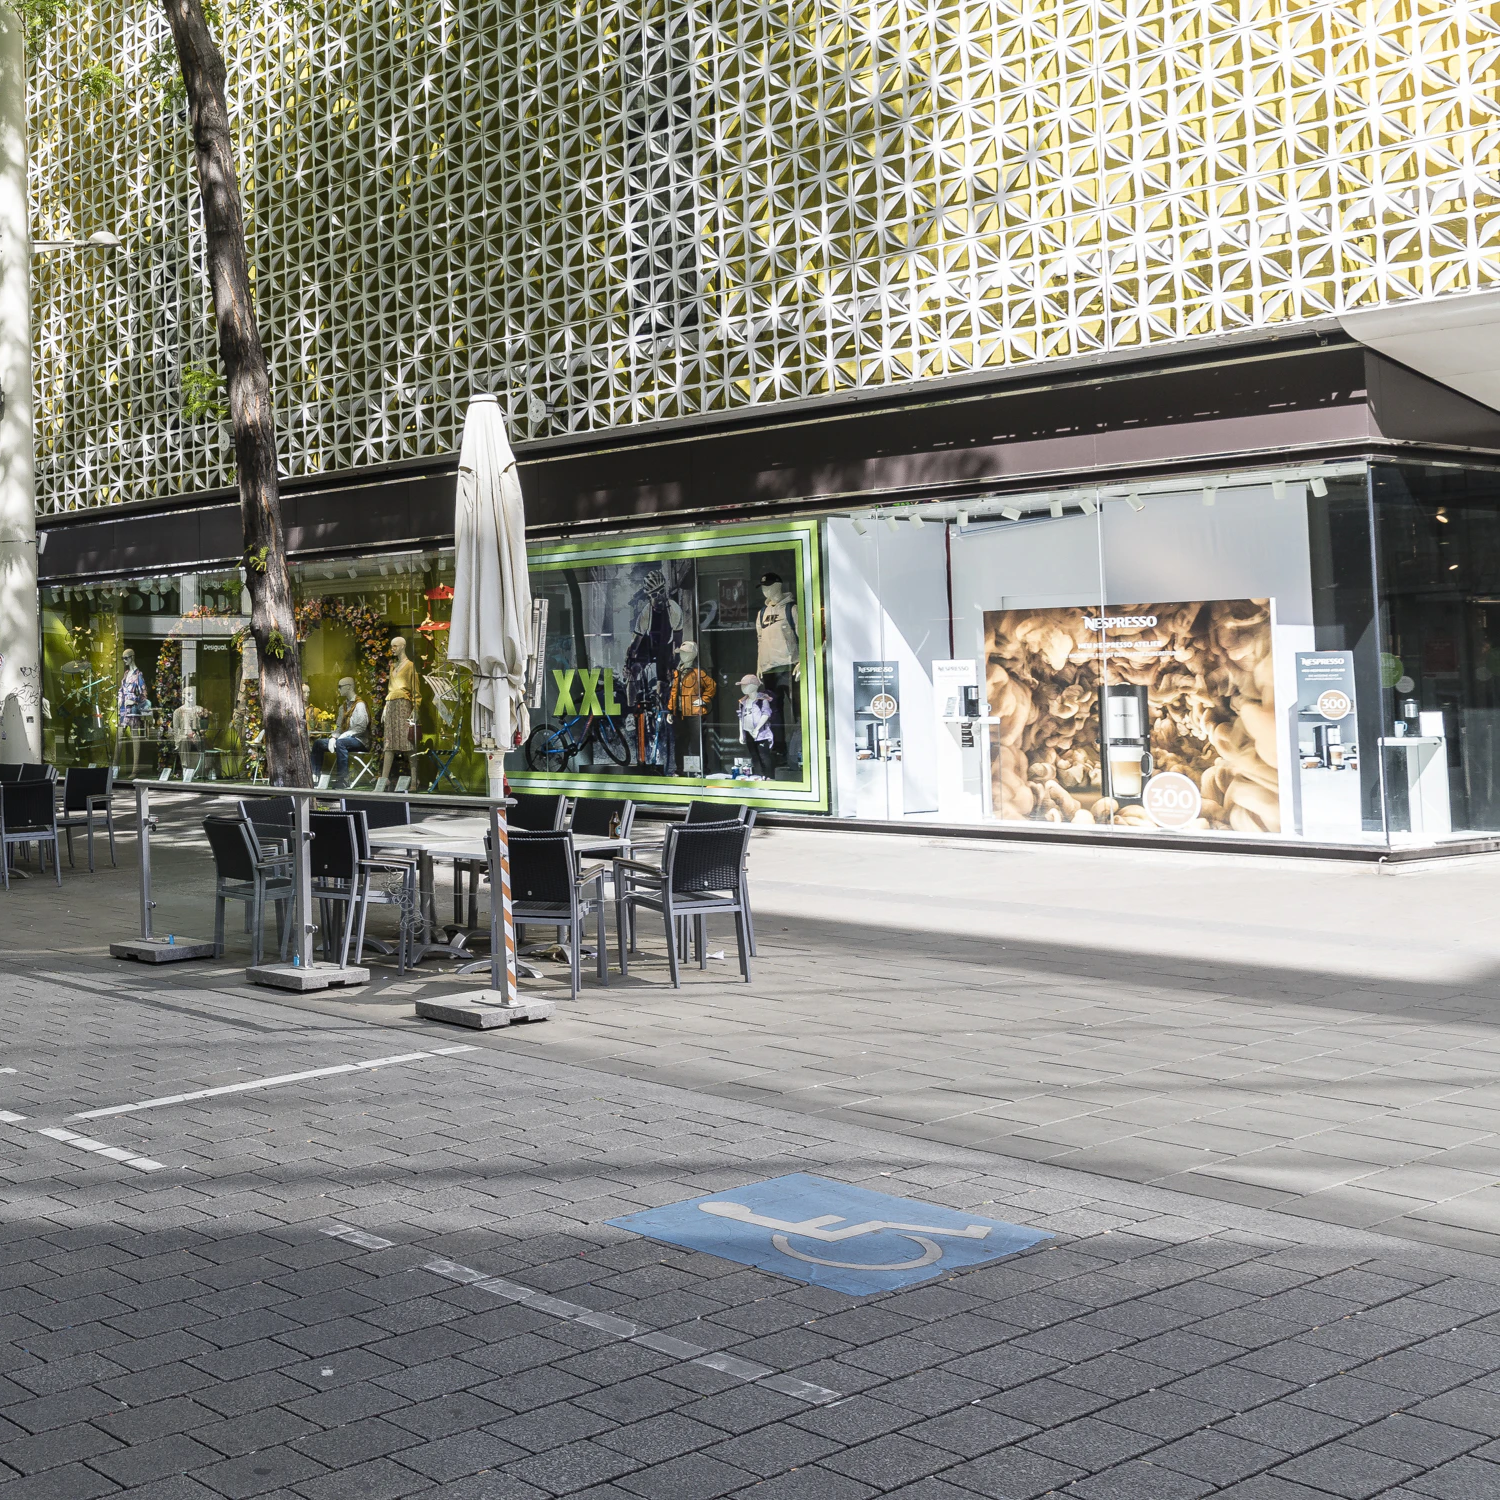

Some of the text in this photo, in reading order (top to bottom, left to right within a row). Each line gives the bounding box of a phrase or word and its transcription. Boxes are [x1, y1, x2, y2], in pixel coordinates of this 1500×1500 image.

[1081, 615, 1158, 632] NESPRESSO
[552, 668, 622, 716] XXL
[873, 700, 894, 710] 300
[1321, 698, 1346, 709] 300
[1150, 788, 1194, 809] 300
